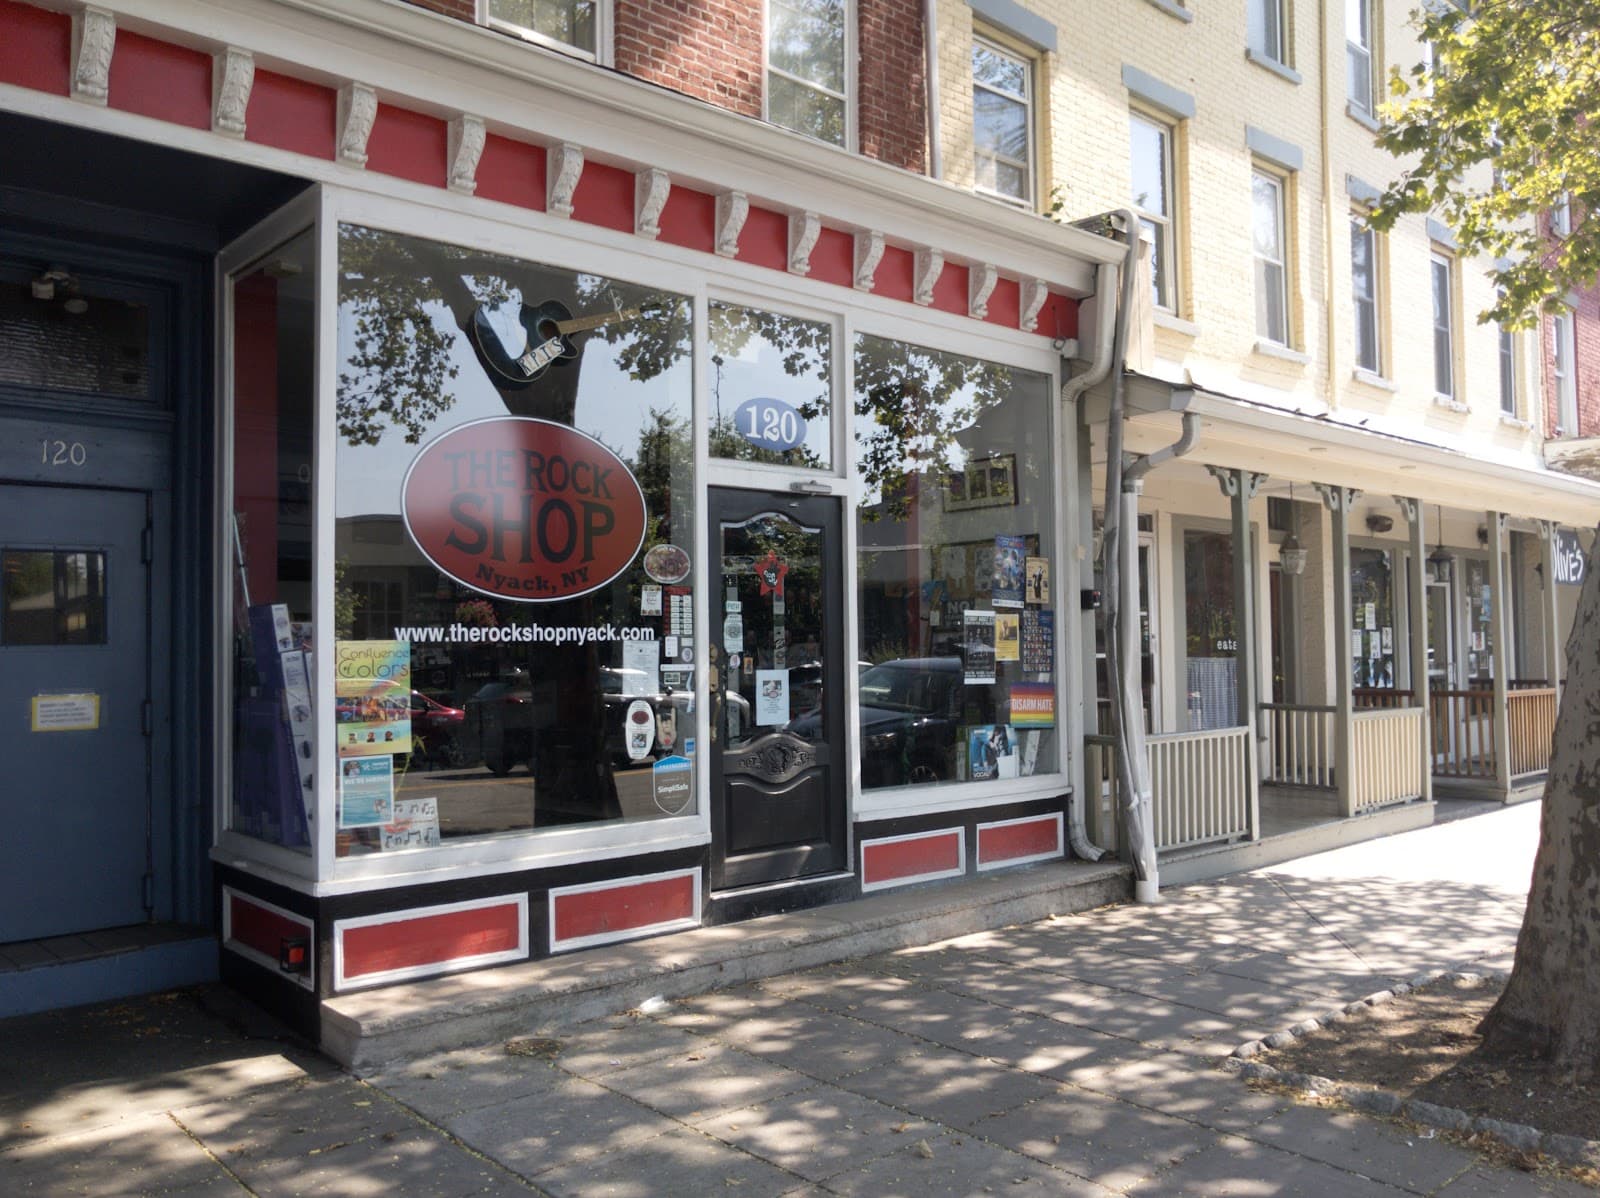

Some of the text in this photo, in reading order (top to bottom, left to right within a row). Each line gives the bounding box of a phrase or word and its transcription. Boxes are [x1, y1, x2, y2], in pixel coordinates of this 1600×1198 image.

[745, 405, 798, 444] 120
[42, 439, 86, 466] 120
[444, 448, 616, 501] THE ROCK
[444, 492, 616, 565] SHOP
[475, 563, 591, 594] Nyack, NY
[394, 622, 655, 646] www.therockshopnyack.com
[338, 658, 410, 678] Colors
[1010, 698, 1054, 712] DISARM HATE
